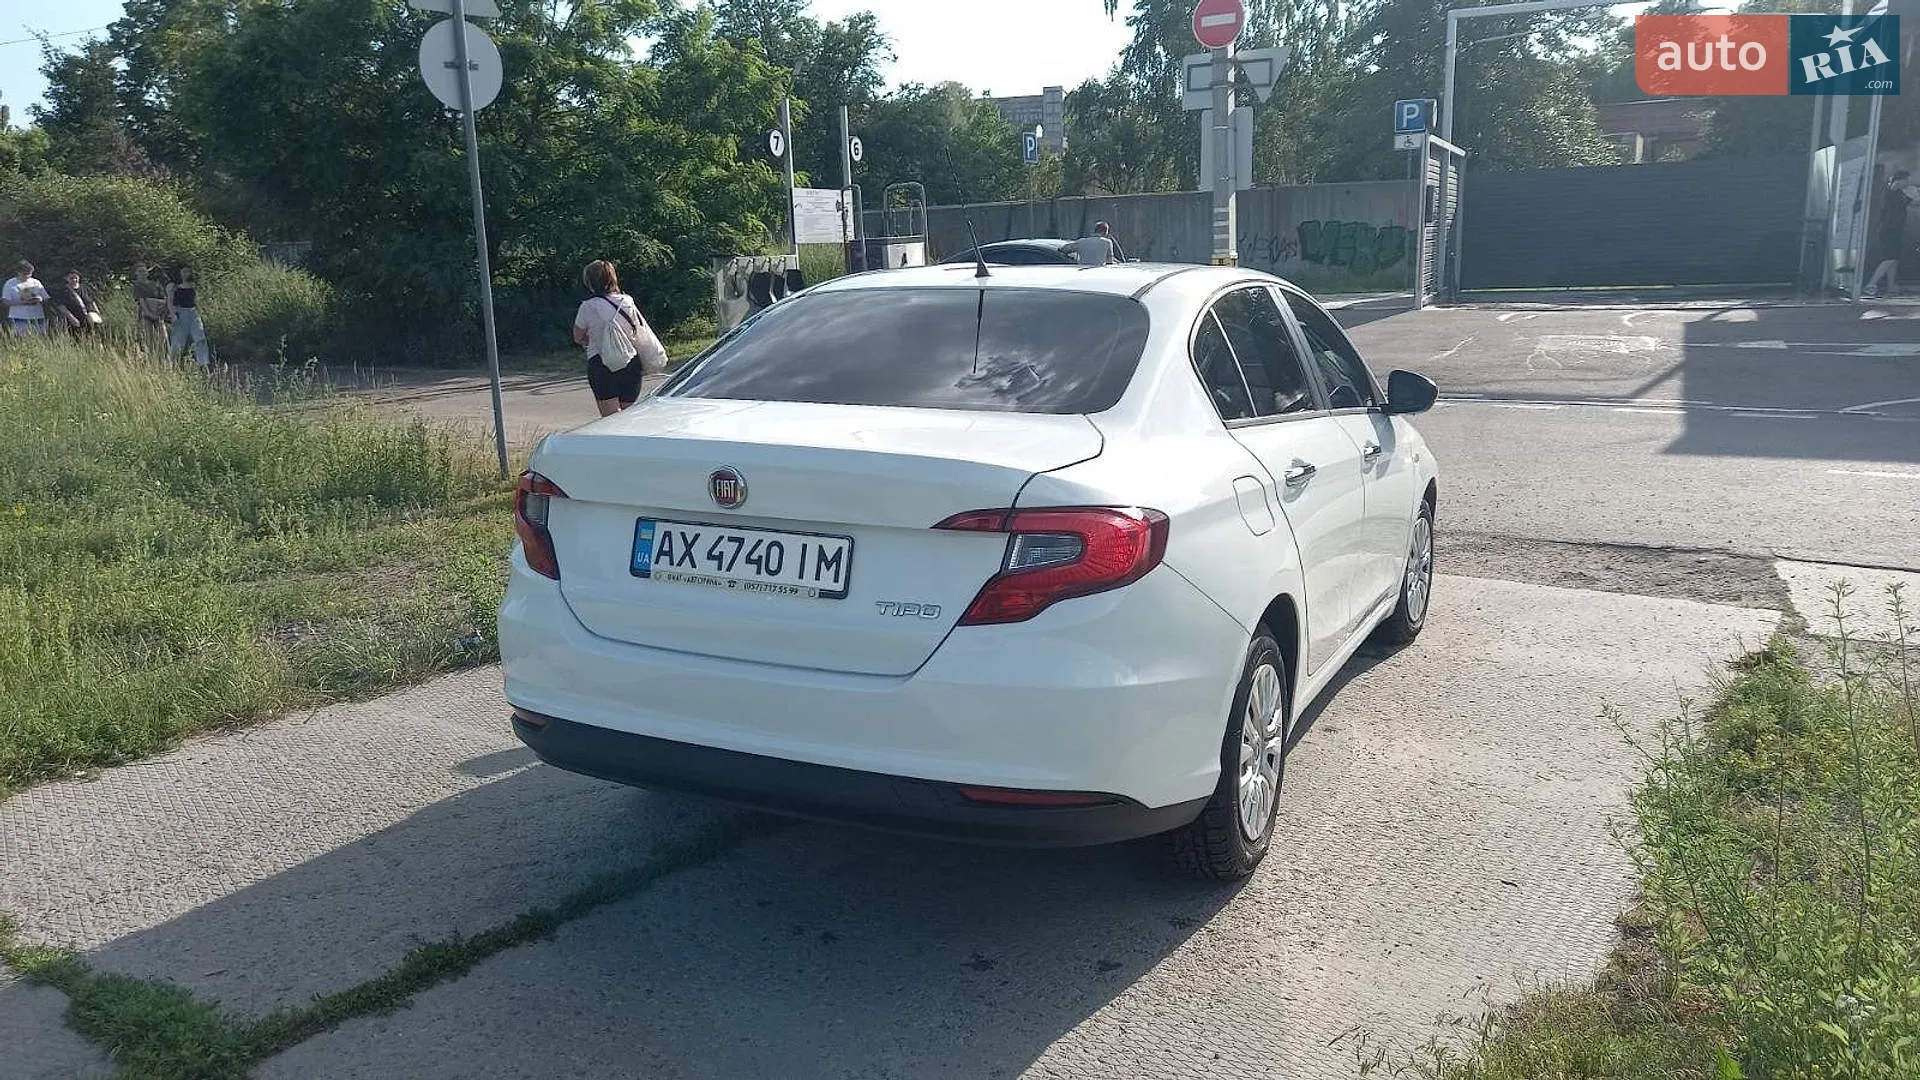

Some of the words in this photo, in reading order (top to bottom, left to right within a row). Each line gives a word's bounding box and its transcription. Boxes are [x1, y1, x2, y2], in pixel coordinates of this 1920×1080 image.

[1403, 103, 1420, 128] P
[773, 135, 780, 151] 7
[853, 142, 860, 156] 6
[1026, 136, 1035, 159] P
[716, 479, 736, 498] FIAT
[637, 552, 651, 563] UA
[654, 530, 701, 569] AX
[706, 535, 785, 577] 4740
[798, 543, 843, 584] IM
[875, 601, 942, 620] TIPO
